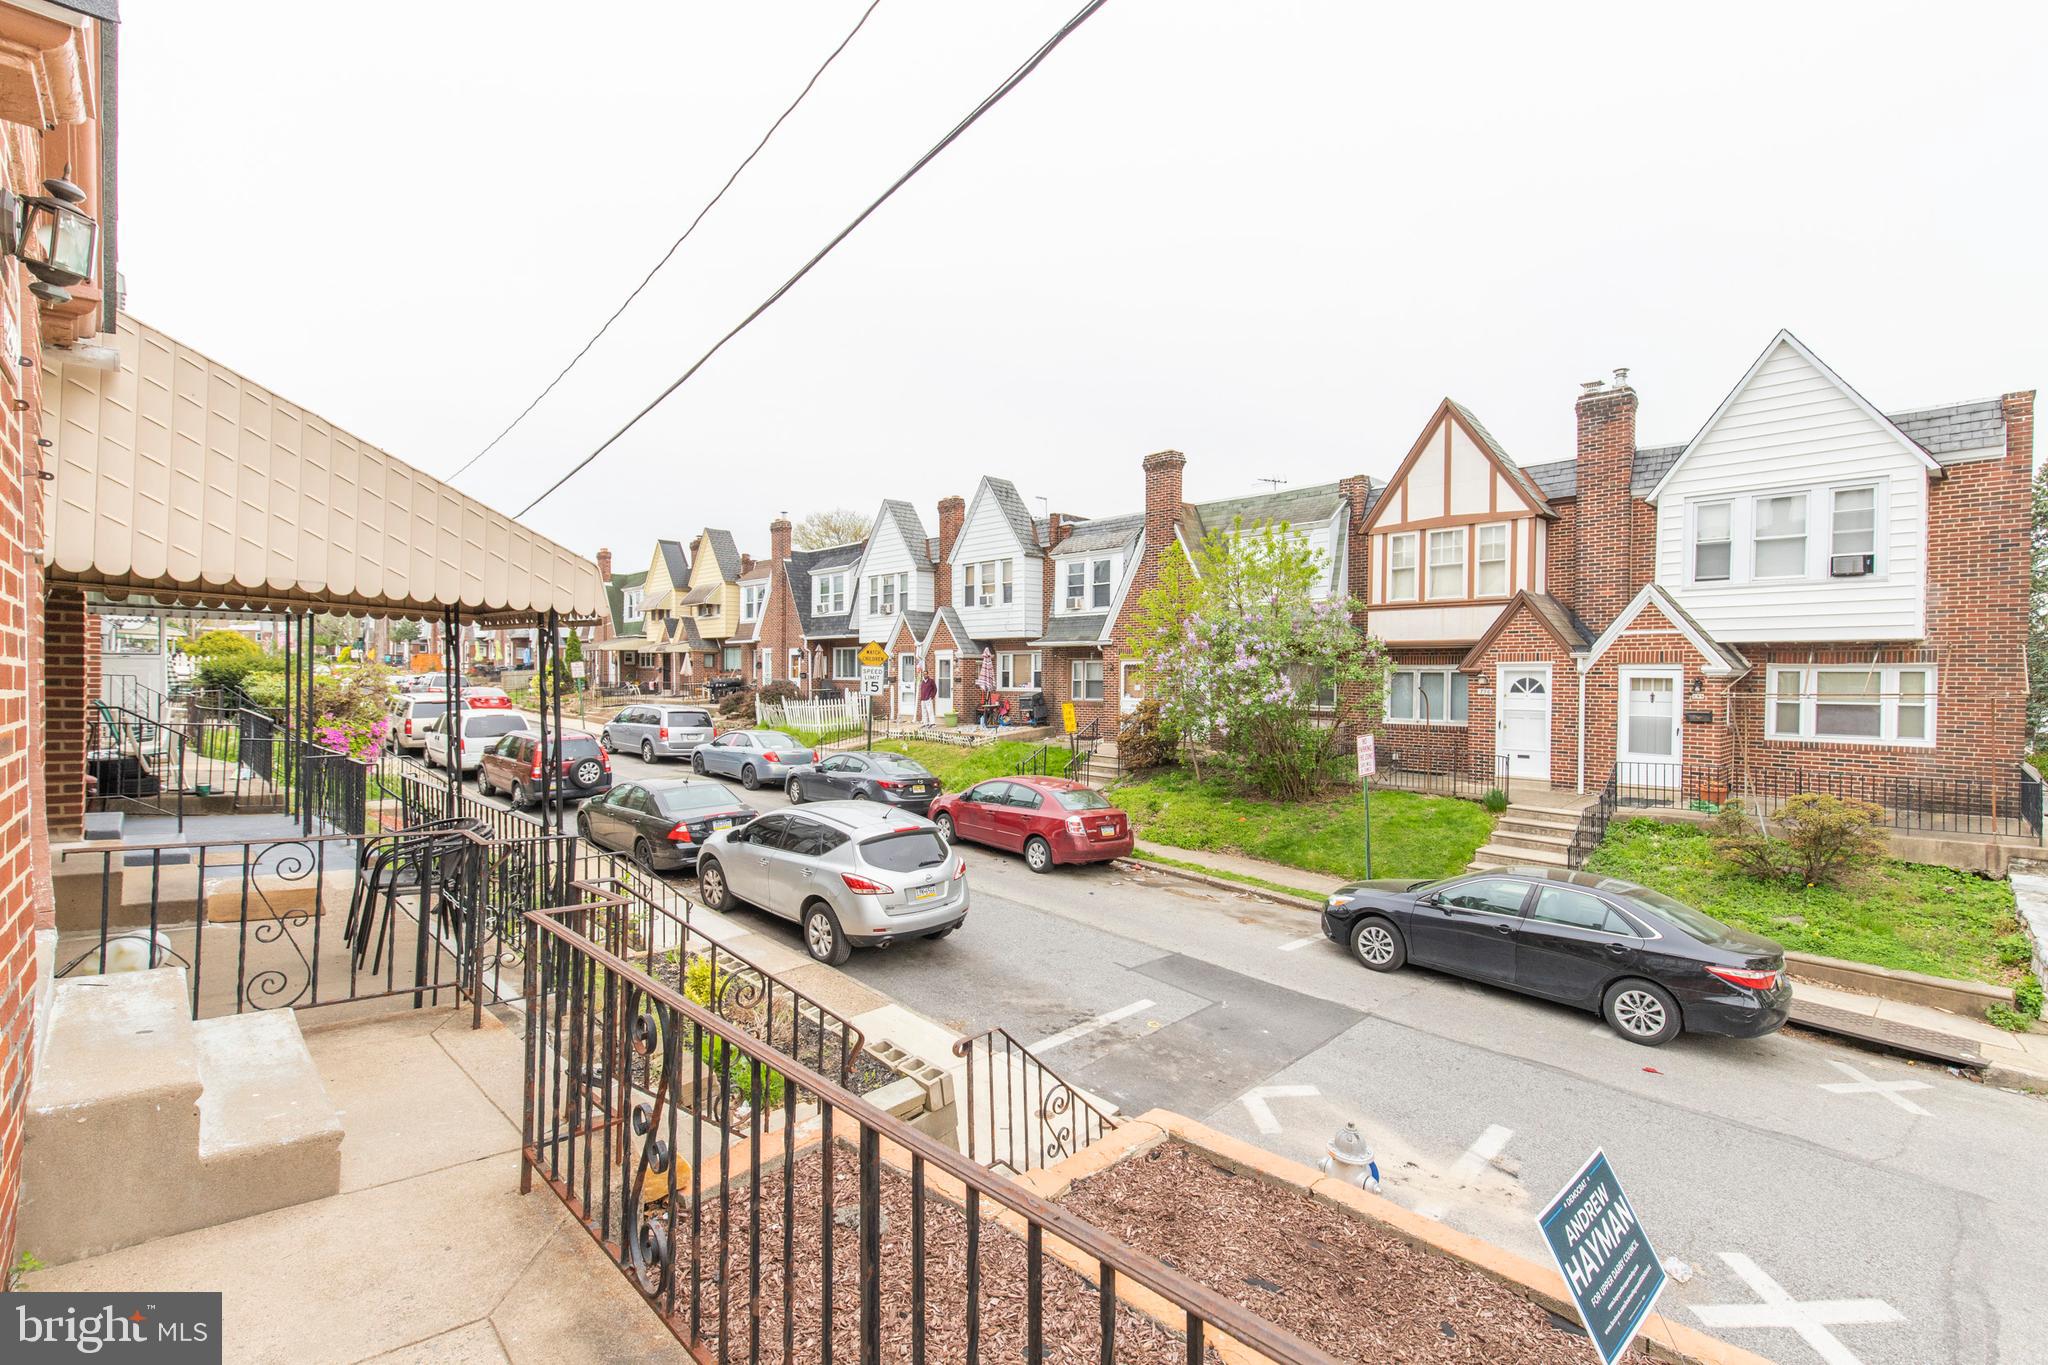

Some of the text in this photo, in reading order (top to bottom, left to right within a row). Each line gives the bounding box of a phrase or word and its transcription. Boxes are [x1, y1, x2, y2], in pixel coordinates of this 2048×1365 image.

[864, 681, 879, 693] 15
[1564, 1182, 1609, 1248] ANDREW
[1565, 1178, 1588, 1207] DEMOCRAT
[1564, 1195, 1635, 1297] HAYMAN
[1590, 1291, 1602, 1309] FOR
[1599, 1274, 1615, 1296] UPPER
[1611, 1258, 1626, 1280] DARBY
[1623, 1239, 1640, 1263] COUNCIL
